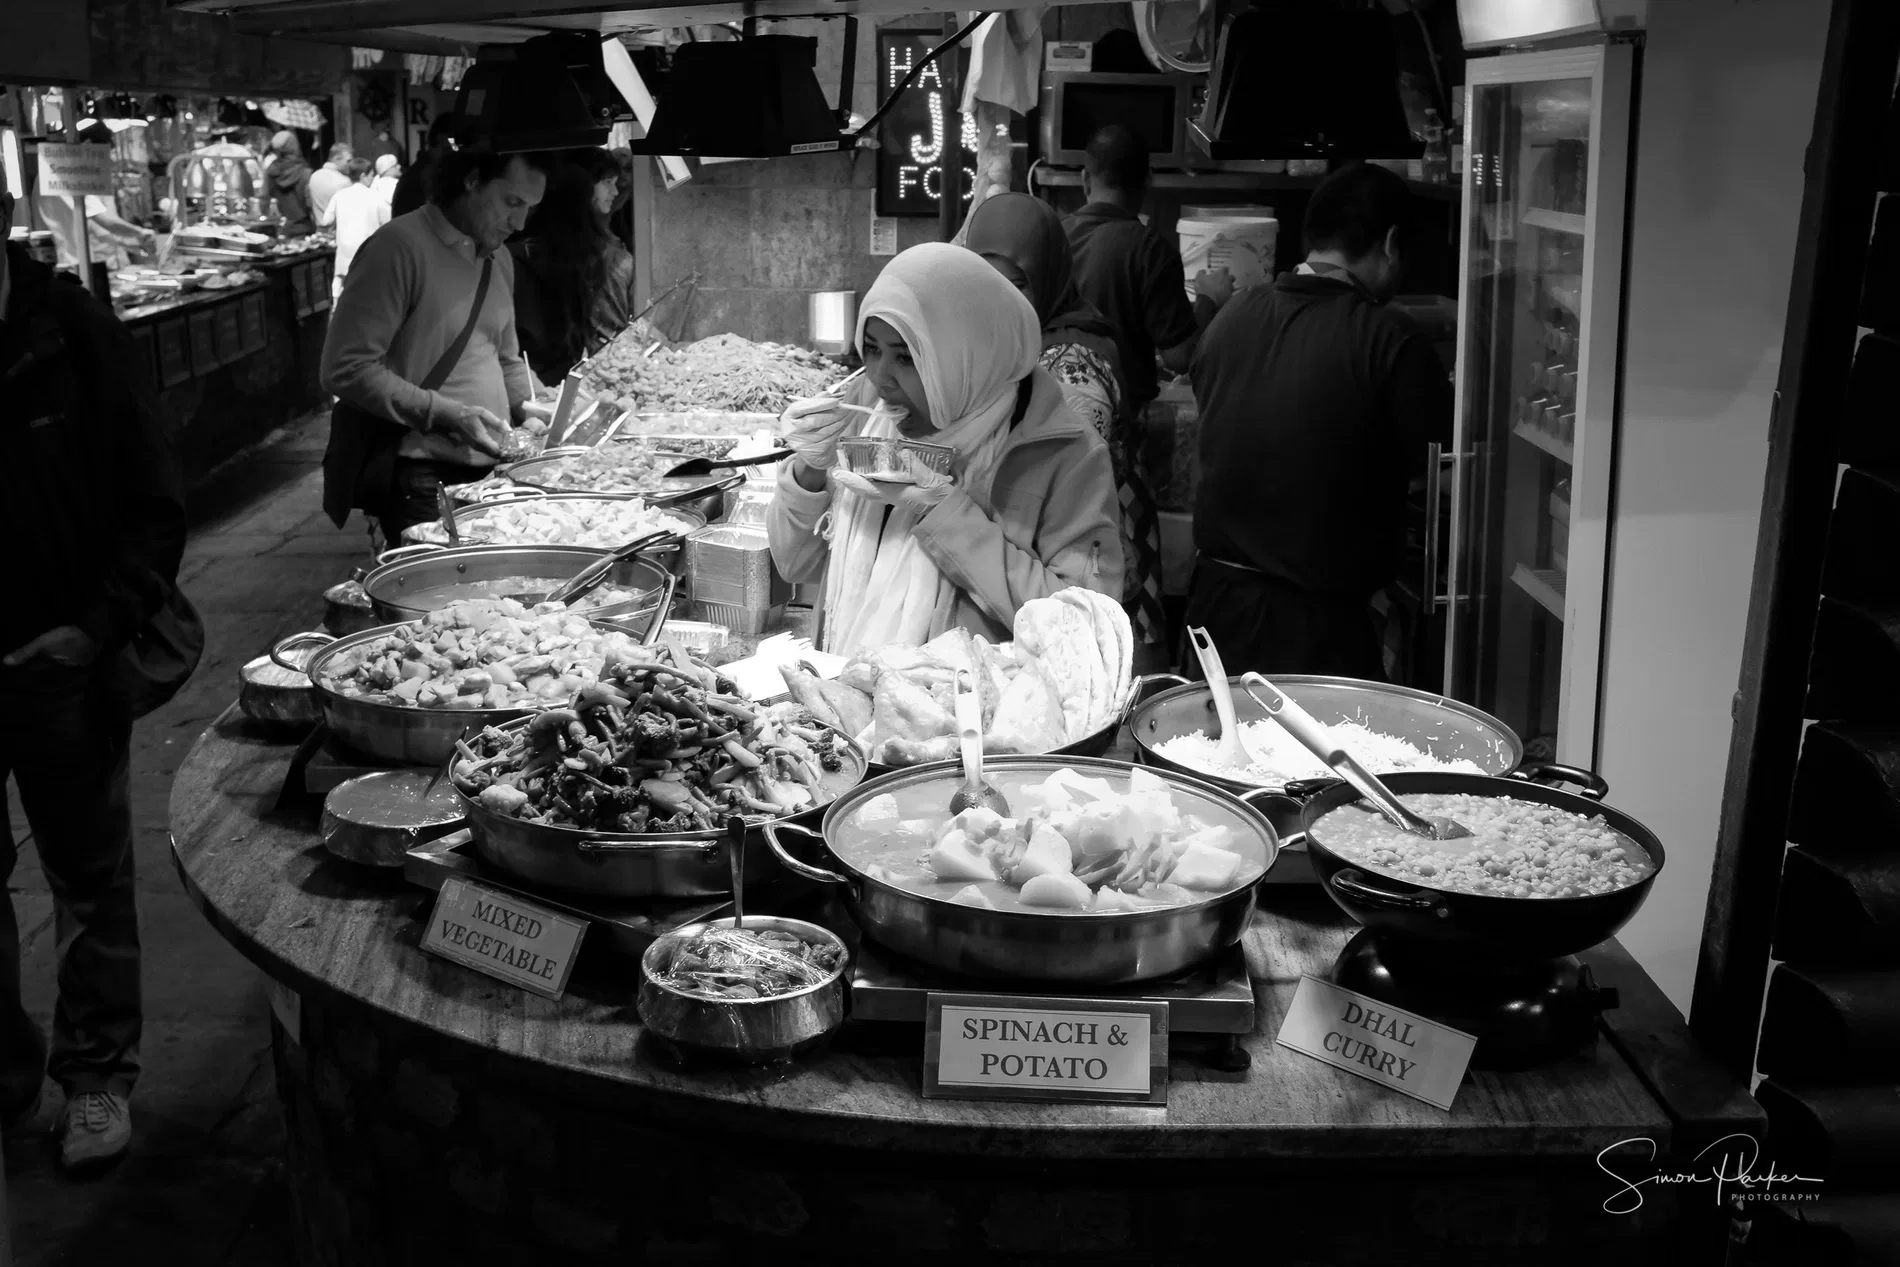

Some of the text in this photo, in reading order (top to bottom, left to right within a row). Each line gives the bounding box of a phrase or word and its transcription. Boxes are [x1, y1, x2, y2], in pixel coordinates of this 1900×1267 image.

[471, 900, 543, 940] MIXED
[442, 920, 558, 981] VEGETABLE
[962, 1017, 1129, 1047] SPINACH &
[1341, 1001, 1417, 1048] DHAL
[979, 1053, 1108, 1080] POTATO
[1323, 1031, 1417, 1081] CURRY
